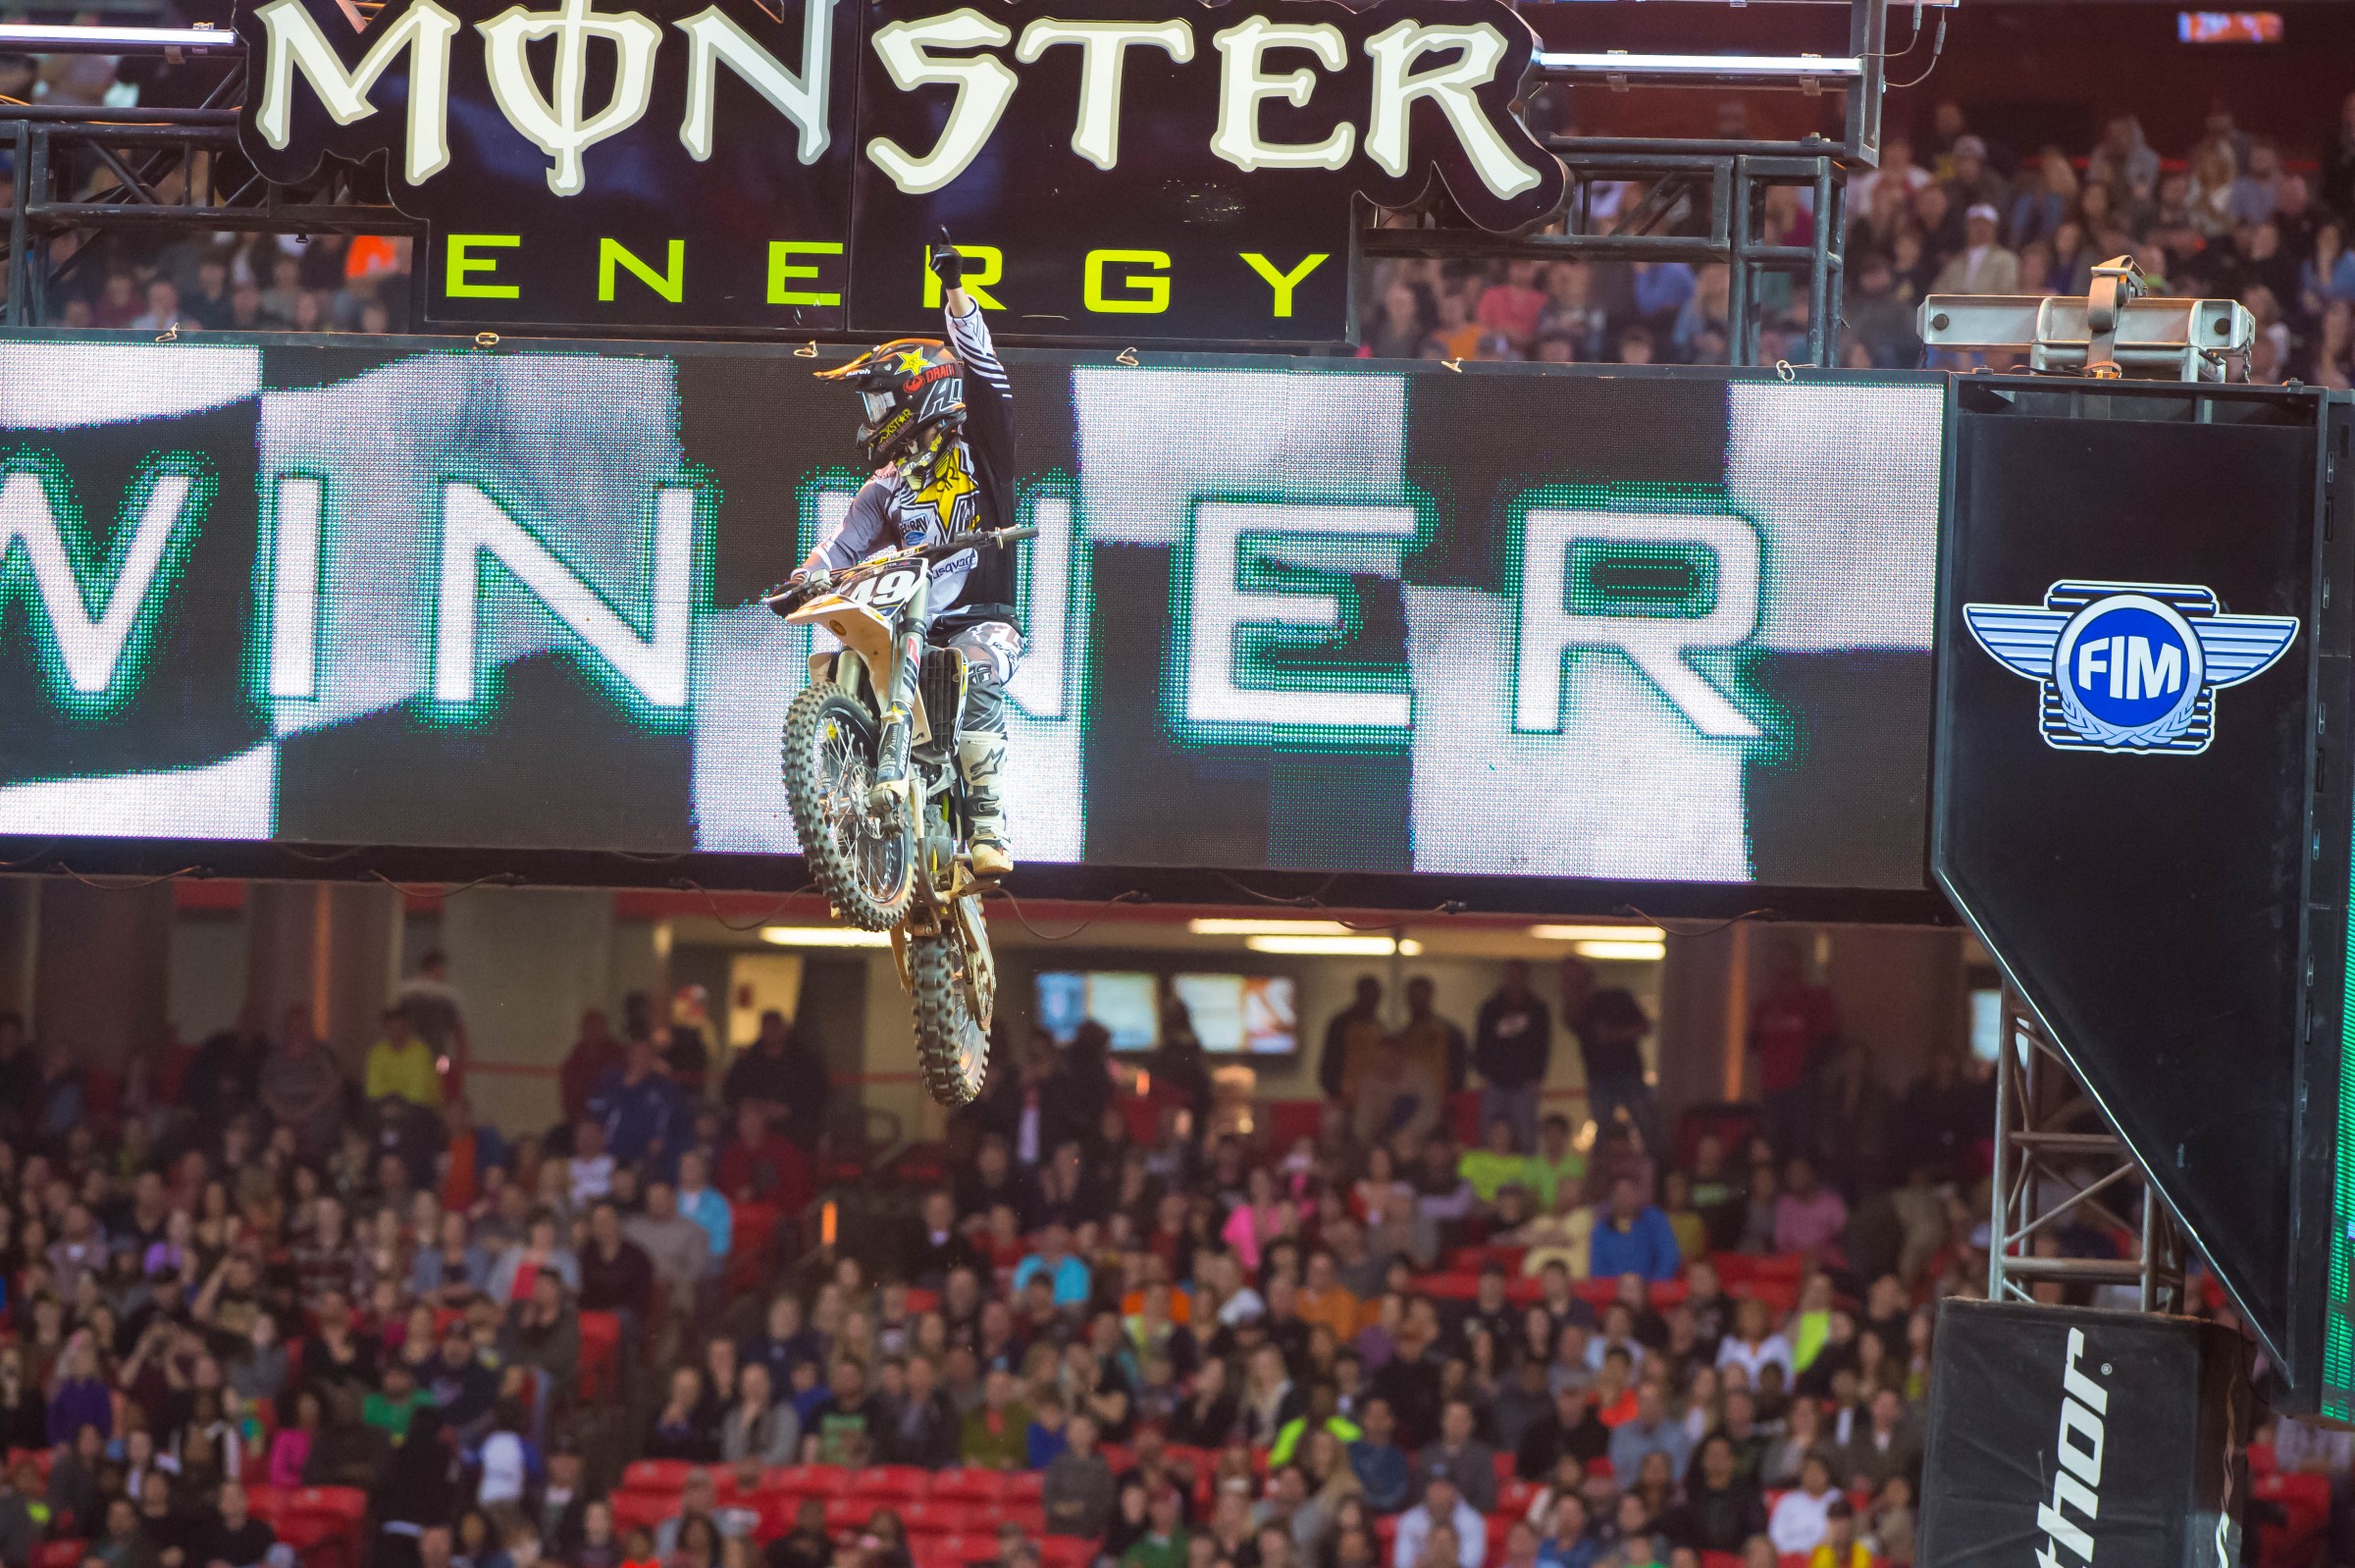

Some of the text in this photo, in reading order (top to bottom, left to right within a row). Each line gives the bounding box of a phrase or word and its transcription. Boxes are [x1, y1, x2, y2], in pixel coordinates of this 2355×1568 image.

[253, 0, 1543, 200] MONSTER
[445, 234, 1331, 319] ENERGY
[2077, 635, 2182, 701] FIM
